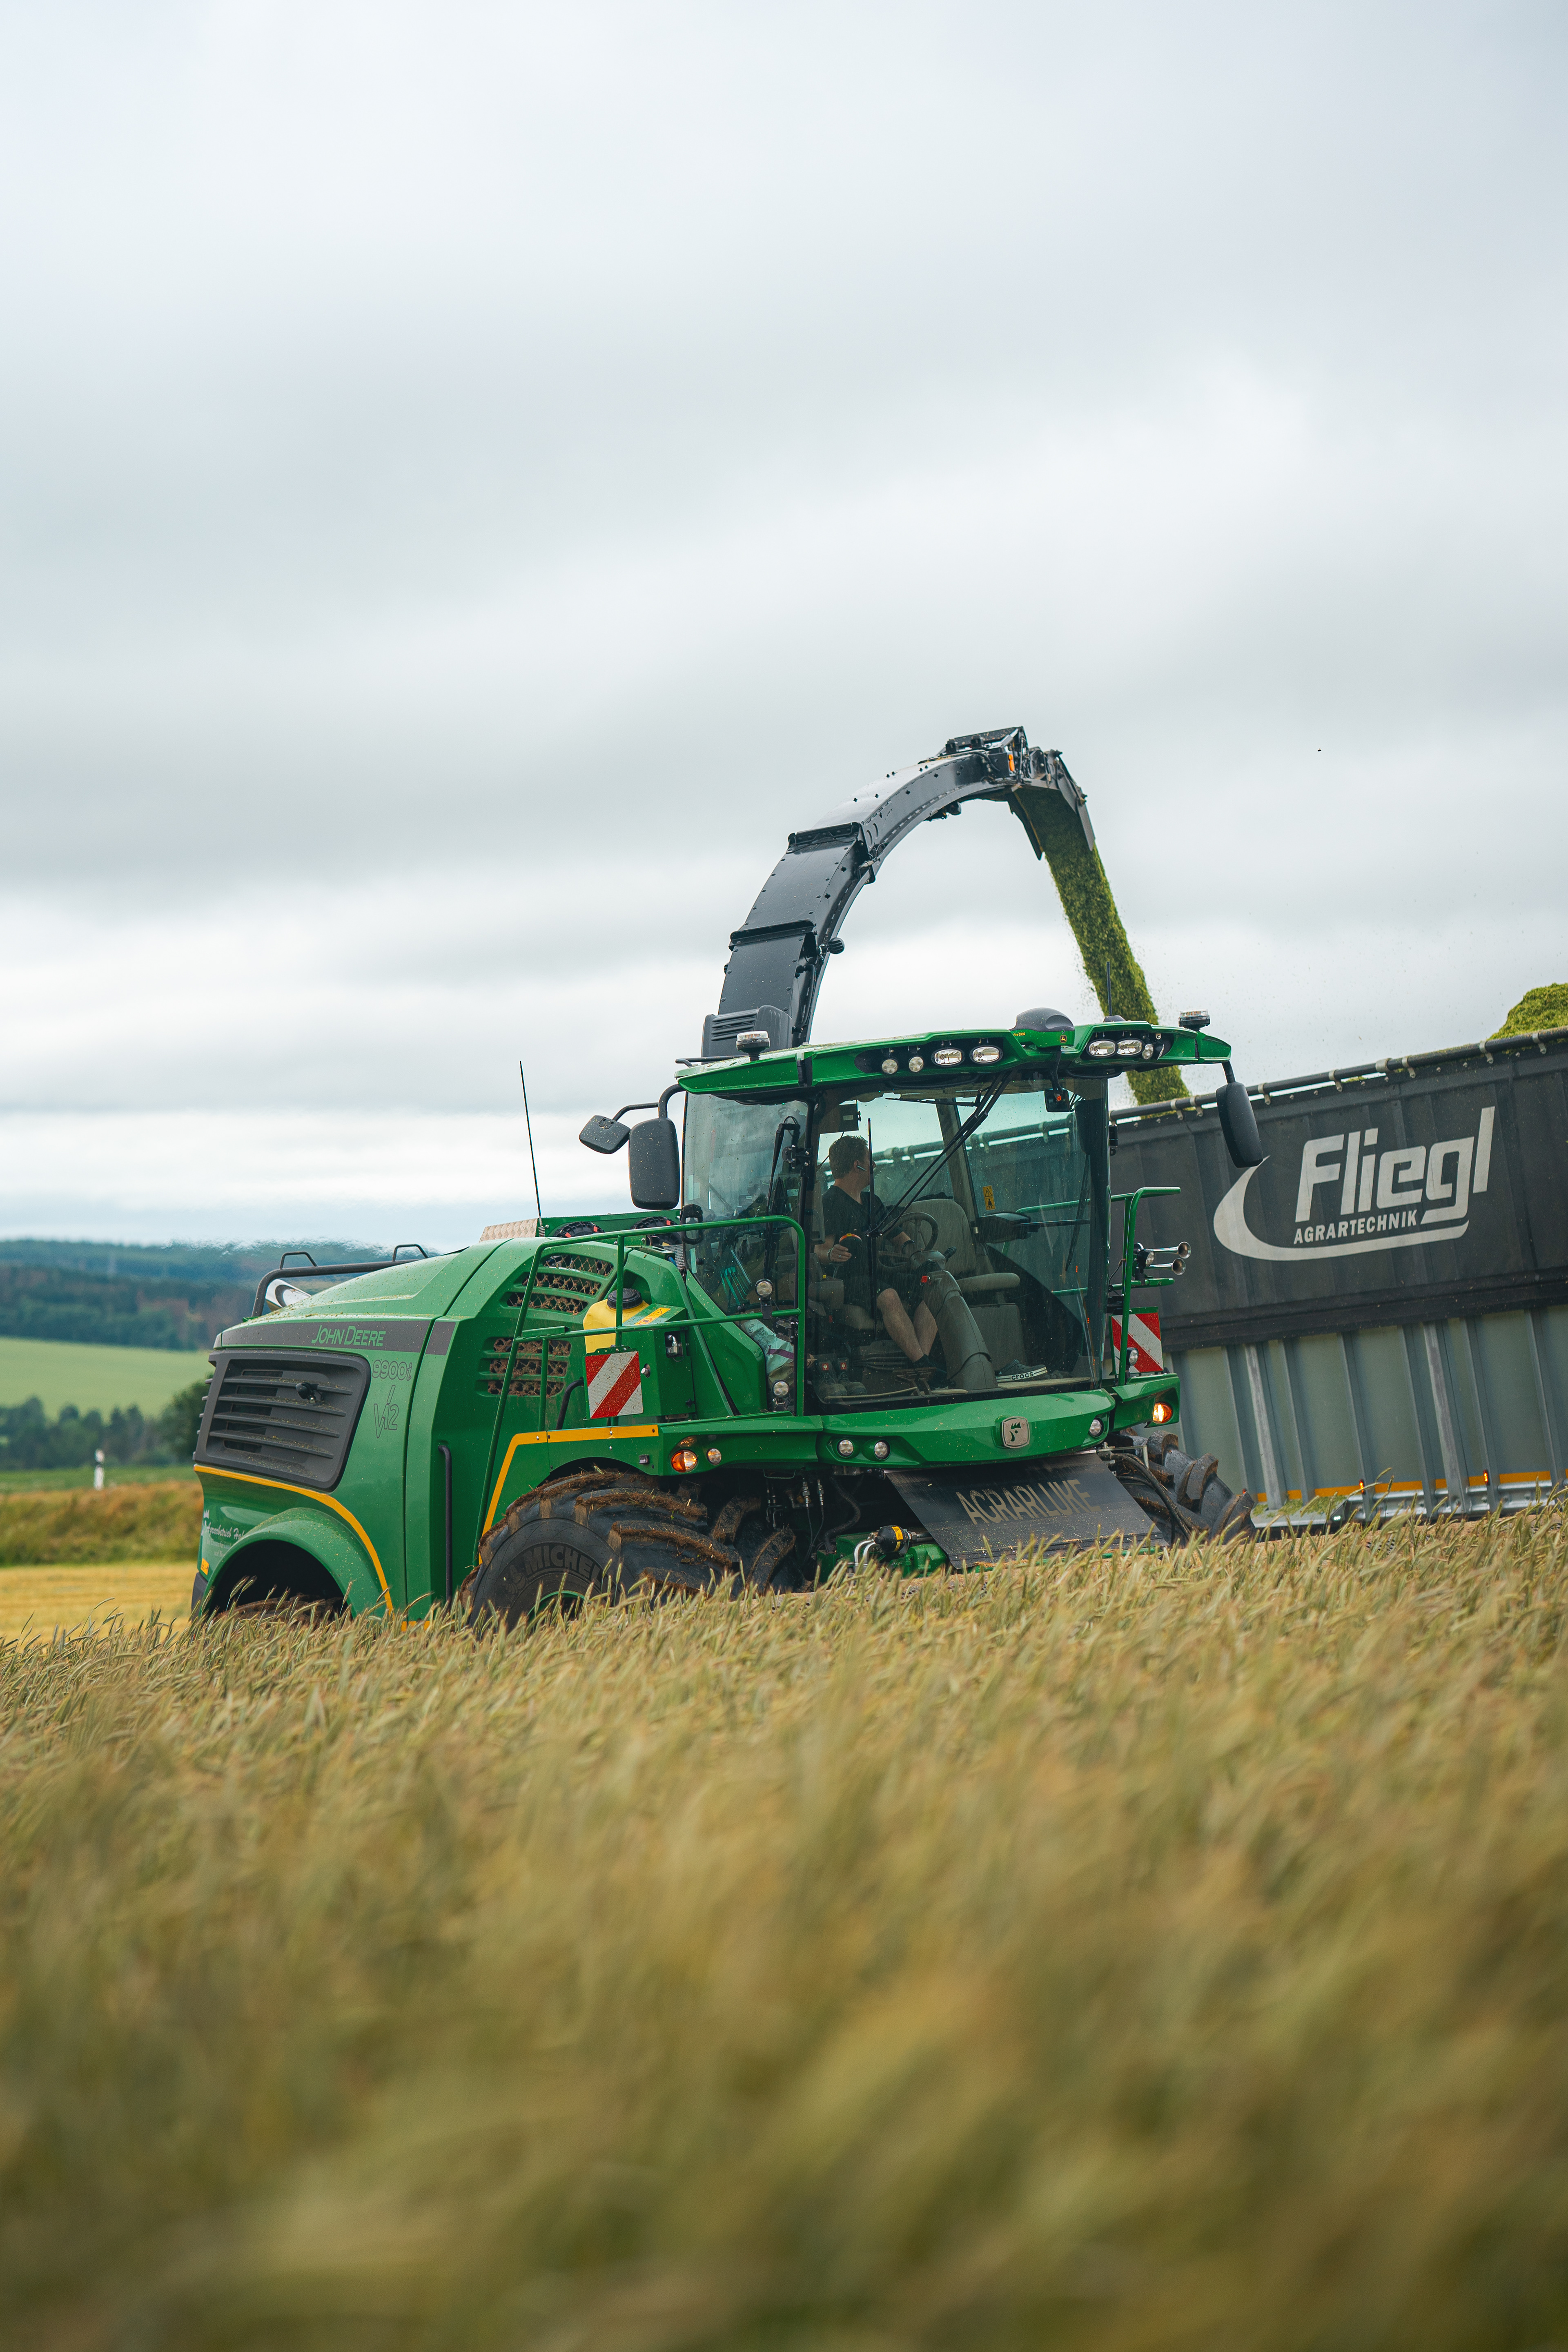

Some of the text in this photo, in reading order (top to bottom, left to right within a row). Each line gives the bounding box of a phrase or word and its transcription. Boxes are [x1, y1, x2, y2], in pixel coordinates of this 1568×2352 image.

[1295, 1106, 1495, 1225] Fliegl
[1294, 1209, 1417, 1245] AGRARTECHNIK
[311, 1325, 386, 1347] JOHN DEERE
[372, 1359, 413, 1381] 9900i
[1011, 1372, 1034, 1380] crocs
[374, 1385, 399, 1439] V12
